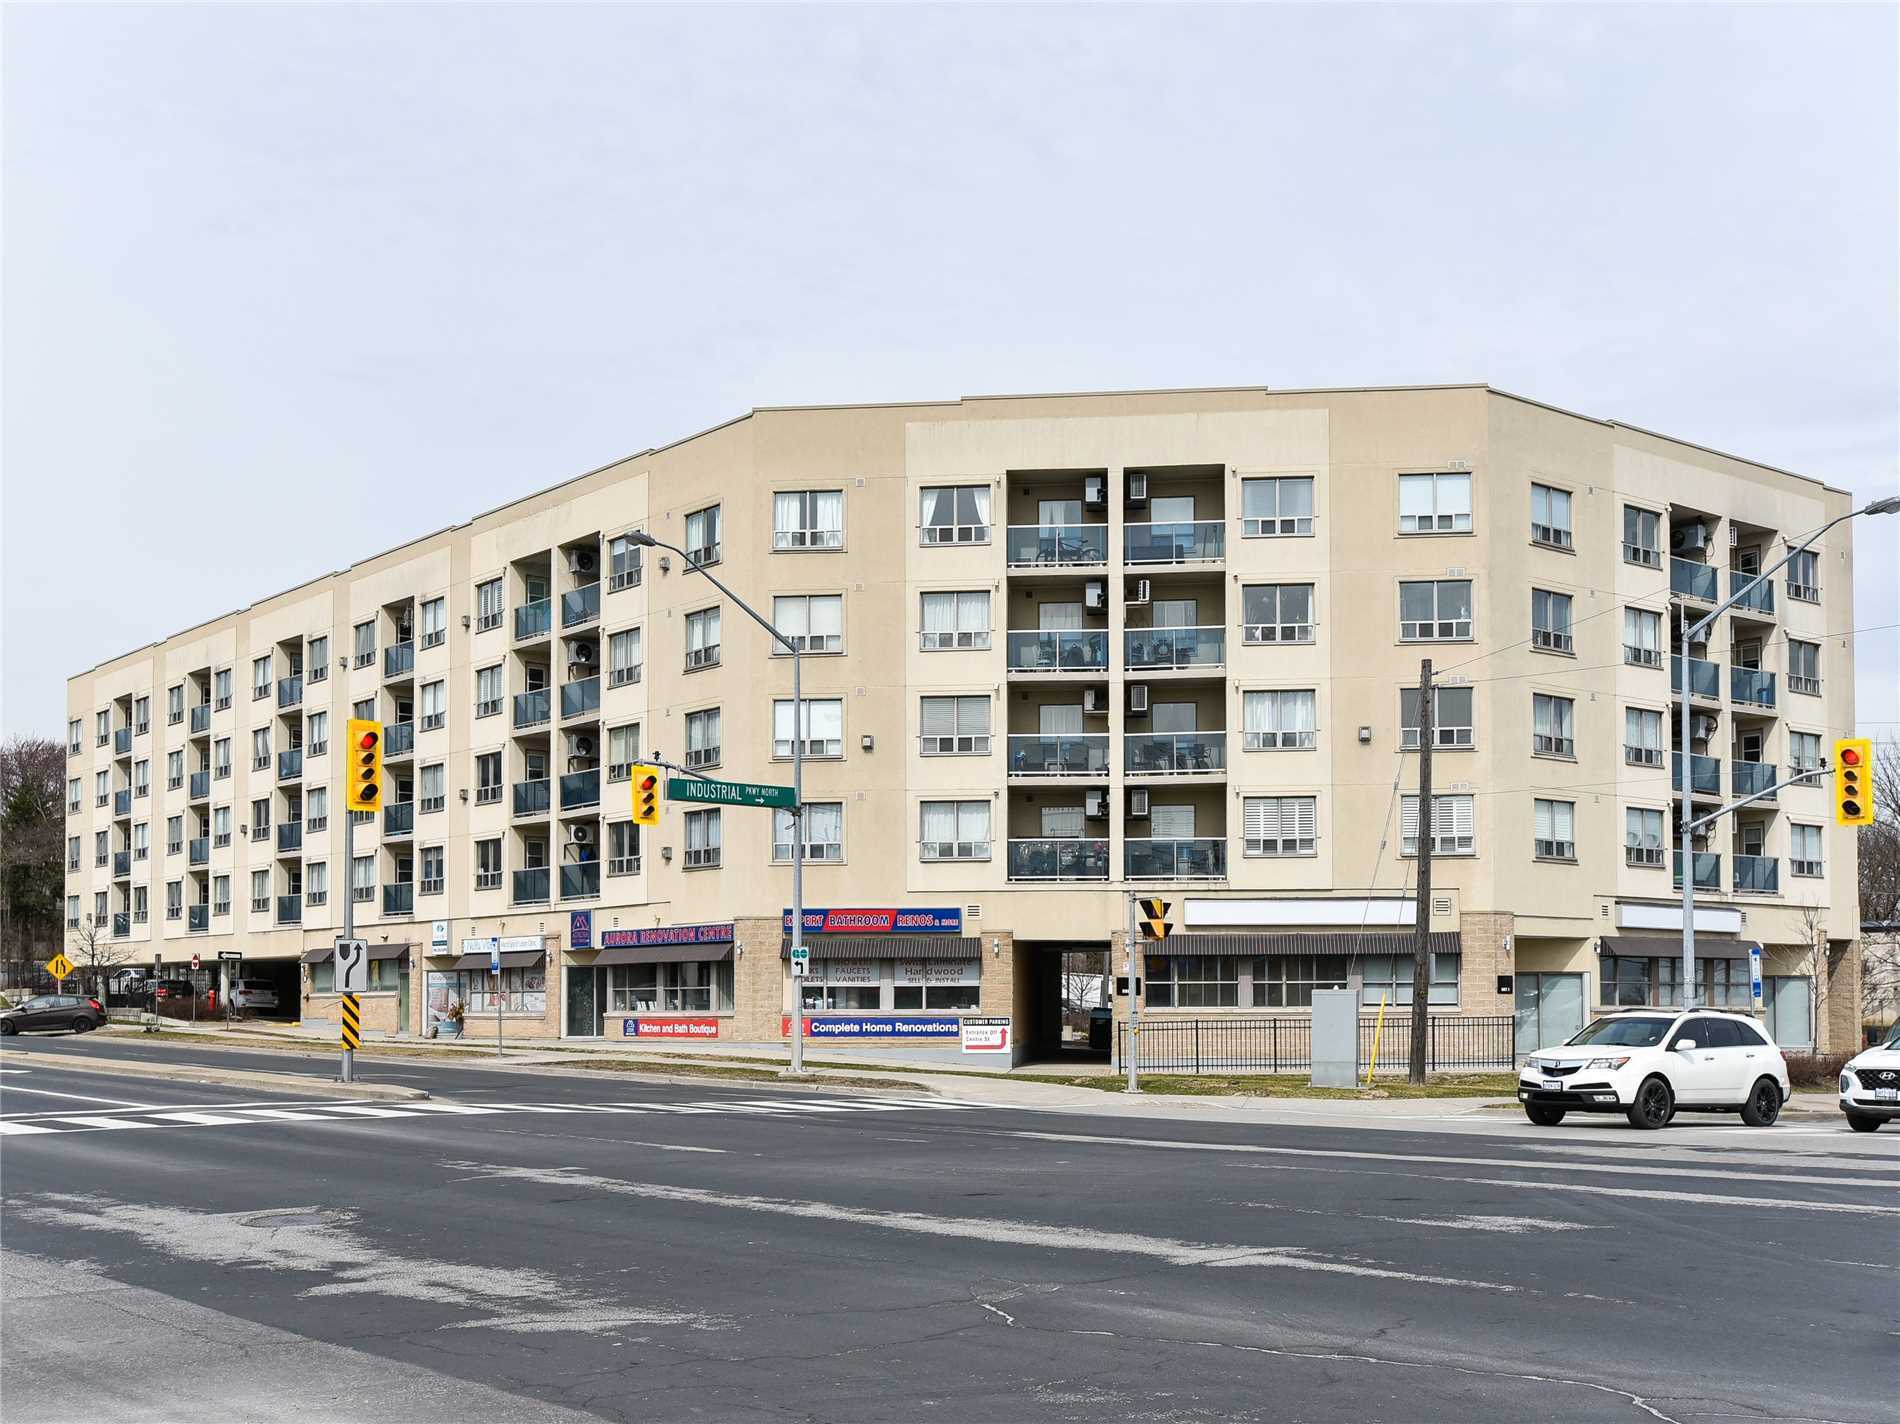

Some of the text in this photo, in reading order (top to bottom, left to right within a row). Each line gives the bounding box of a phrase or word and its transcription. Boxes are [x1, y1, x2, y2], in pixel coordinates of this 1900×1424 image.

[686, 782, 779, 800] INDUSTRIAL PKWY NORTH
[828, 914, 889, 926] BATHROOM
[897, 914, 933, 926] RENOS
[603, 931, 638, 944] AURORA
[641, 928, 695, 943] RENOVATION
[698, 925, 732, 941] CENTRE
[835, 967, 871, 975] FAUCETS
[904, 967, 964, 976] Hardwood
[640, 1023, 717, 1035] Kitchen and Bath Boutique
[811, 1022, 958, 1034] Complete Home Renovations
